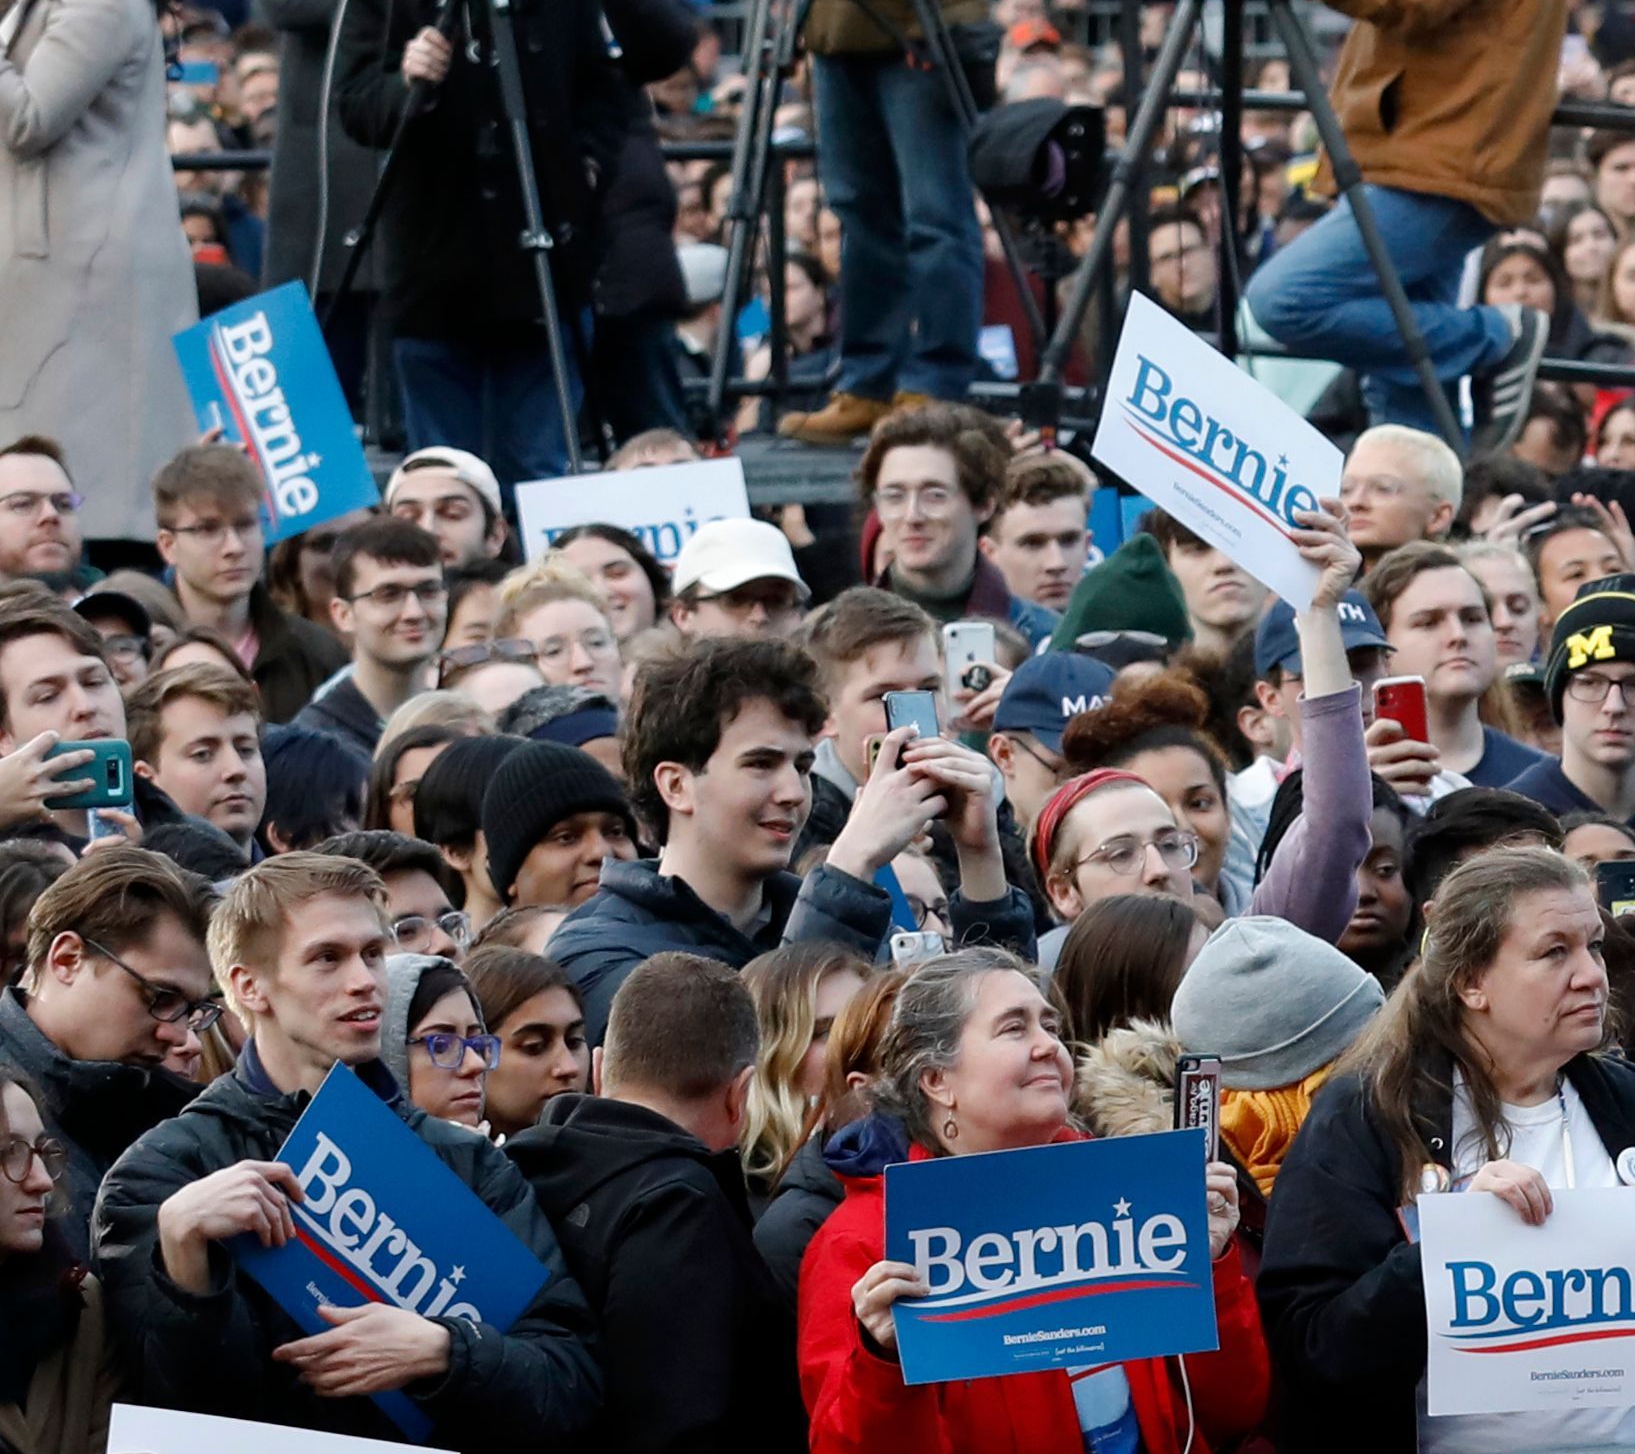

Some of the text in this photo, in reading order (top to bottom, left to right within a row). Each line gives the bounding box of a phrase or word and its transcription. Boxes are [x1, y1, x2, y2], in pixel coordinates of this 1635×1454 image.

[220, 310, 319, 517] Bernie
[1126, 353, 1319, 530] Bernie
[1566, 624, 1616, 669] M
[908, 1196, 1188, 1295] Bernie
[1003, 1325, 1106, 1345] BernieSanders.com
[1530, 1368, 1624, 1382] BernieSanders.com
